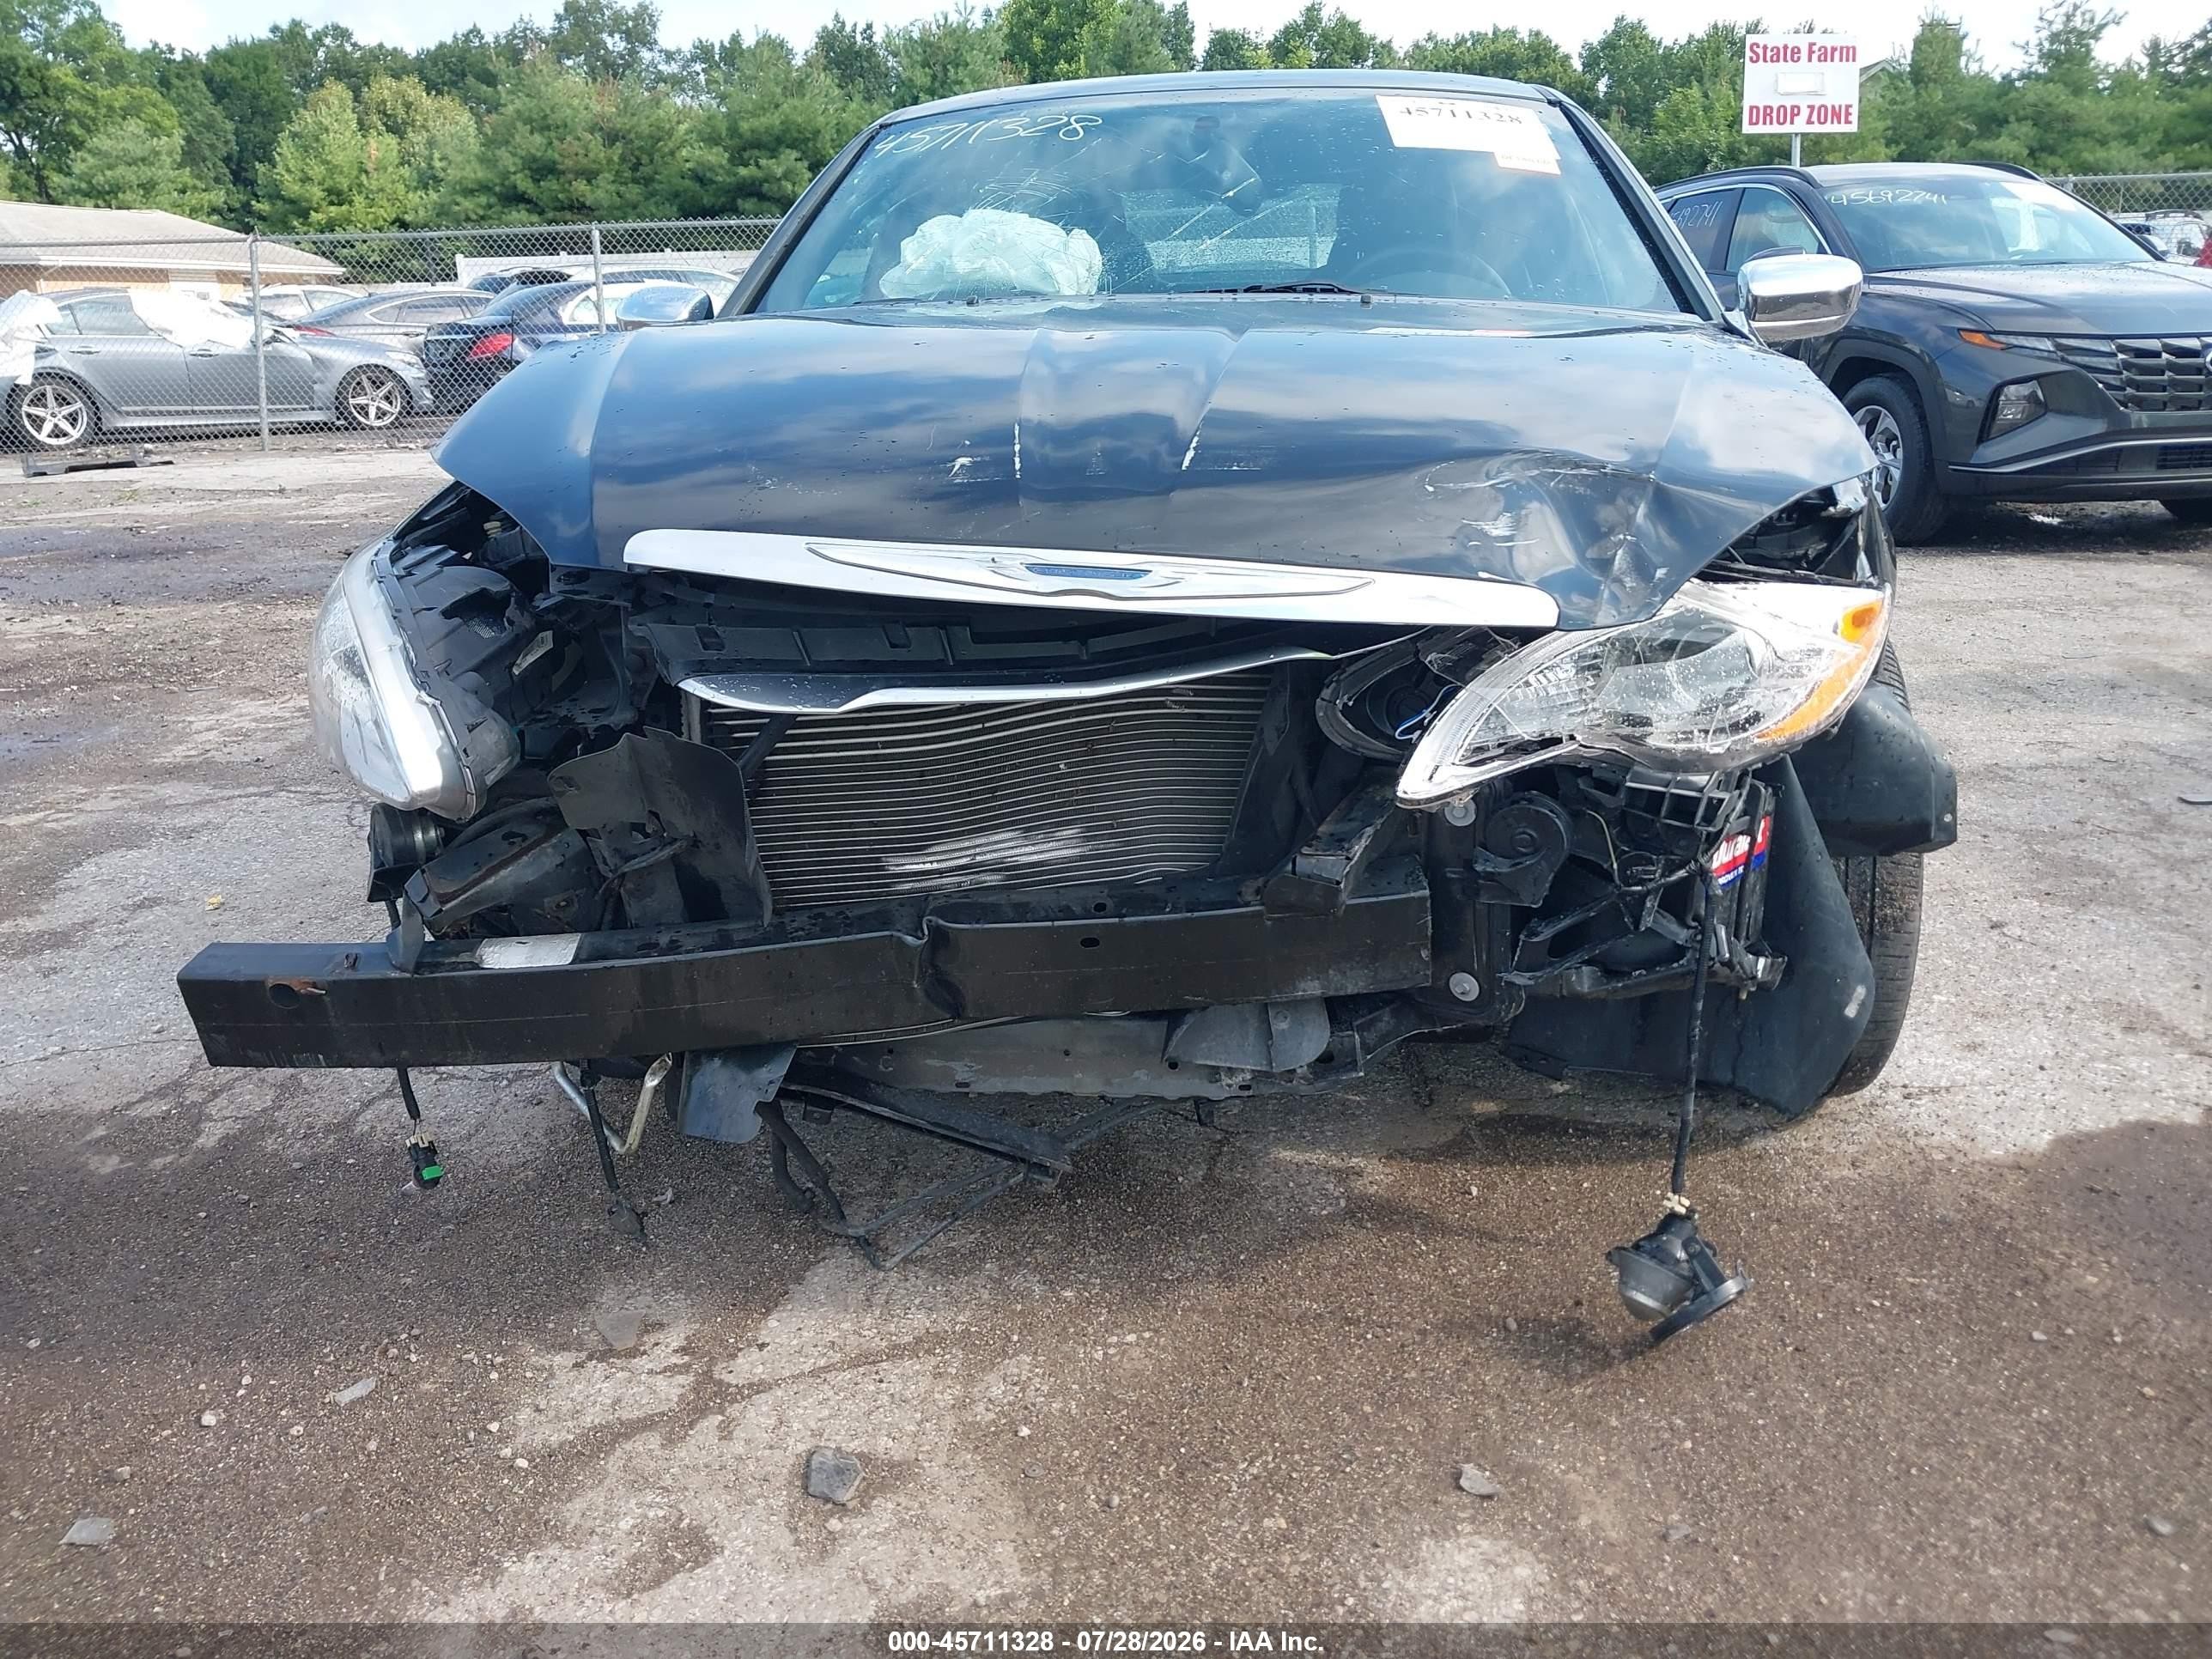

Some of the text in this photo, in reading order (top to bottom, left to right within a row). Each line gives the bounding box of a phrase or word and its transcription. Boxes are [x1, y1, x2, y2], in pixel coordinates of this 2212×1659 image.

[1749, 42, 1857, 64] State Farm
[1400, 103, 1523, 125] 45711328
[1748, 104, 1853, 126] DROP ZONE
[874, 114, 1103, 158] 45711328
[1831, 189, 1948, 206] 45692741
